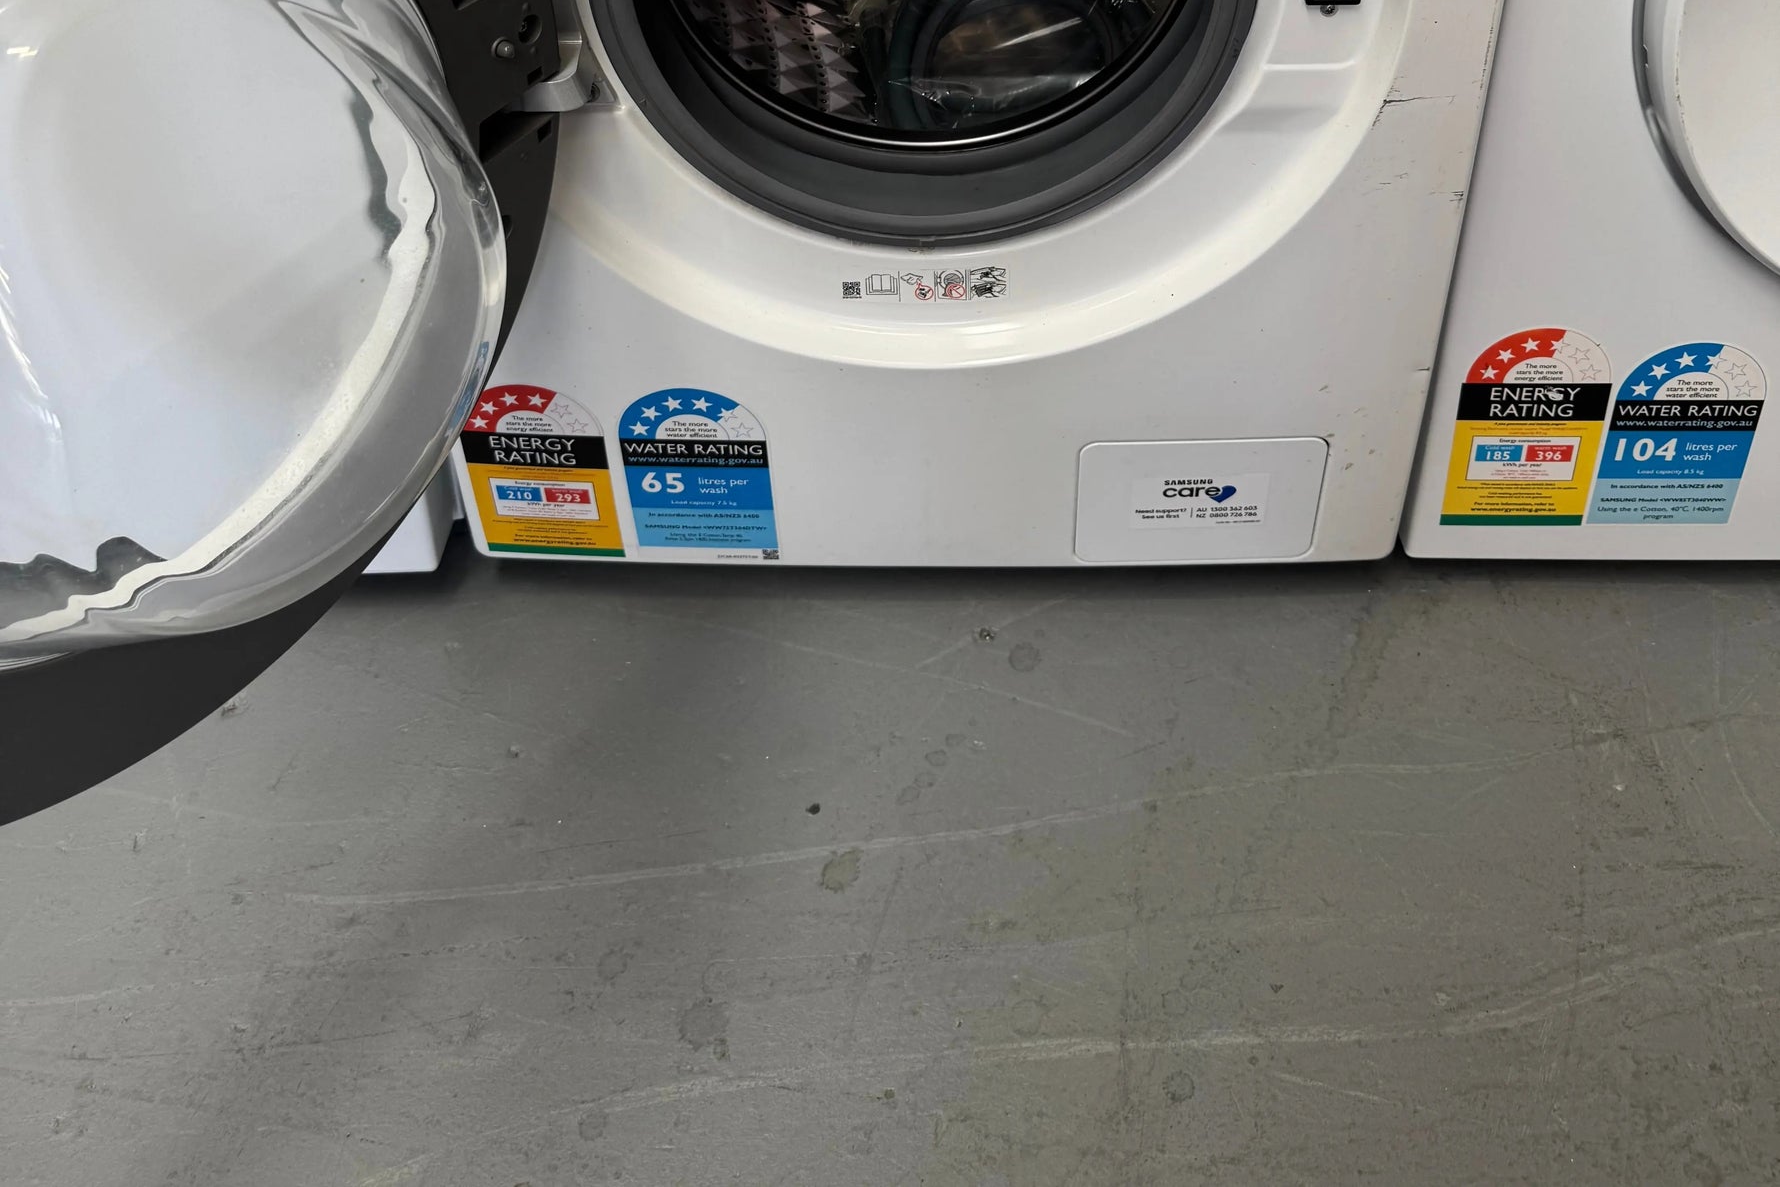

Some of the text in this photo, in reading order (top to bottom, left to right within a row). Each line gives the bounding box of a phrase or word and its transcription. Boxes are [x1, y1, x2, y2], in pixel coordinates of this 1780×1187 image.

[1490, 387, 1581, 402] ENERGY
[1688, 391, 1718, 399] efficient
[1489, 403, 1574, 418] RATING
[1618, 405, 1759, 417] WATER RATING
[1616, 419, 1753, 429] www.waterrating.gov.au
[488, 435, 576, 452] ENERGY
[624, 442, 763, 456] WATER RATING
[1486, 450, 1511, 460] 185
[1535, 450, 1562, 461] 396
[1614, 438, 1738, 462] 104 litres per
[494, 450, 577, 465] RATING
[628, 456, 763, 466] www.waterrating.gov.au
[1683, 452, 1712, 461] wash
[641, 471, 749, 494] 65 litres per
[1164, 478, 1213, 486] SAMSUNG
[506, 490, 532, 500] 210
[700, 486, 728, 494] wash
[1162, 486, 1221, 498] care
[555, 493, 581, 502] 293
